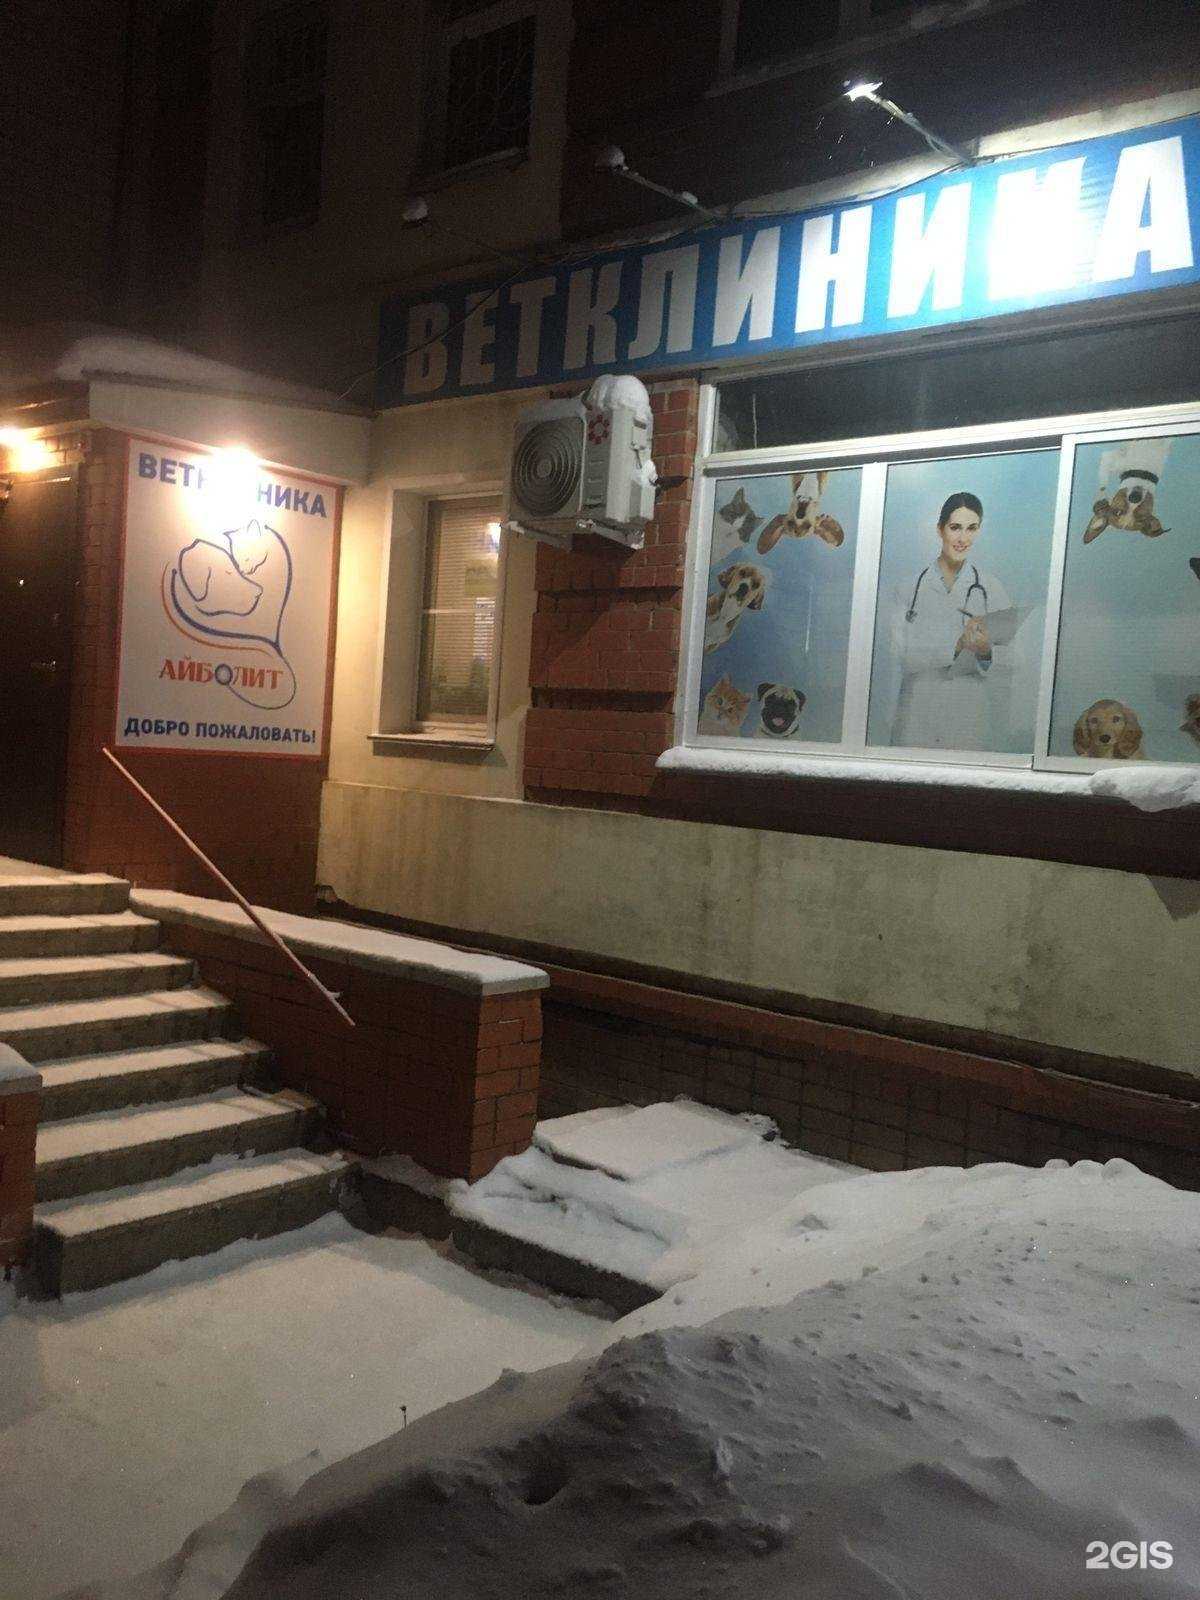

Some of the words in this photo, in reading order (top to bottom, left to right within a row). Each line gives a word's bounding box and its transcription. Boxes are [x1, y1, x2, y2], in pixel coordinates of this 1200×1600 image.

[401, 136, 1194, 397] ВЕТКЛИНИА
[138, 452, 327, 518] ВЕТНИКА
[158, 655, 283, 690] АЙБОЛИТ
[124, 718, 190, 736] ДОБРО
[195, 722, 316, 743] ПОЖАЛОВАТЬ!
